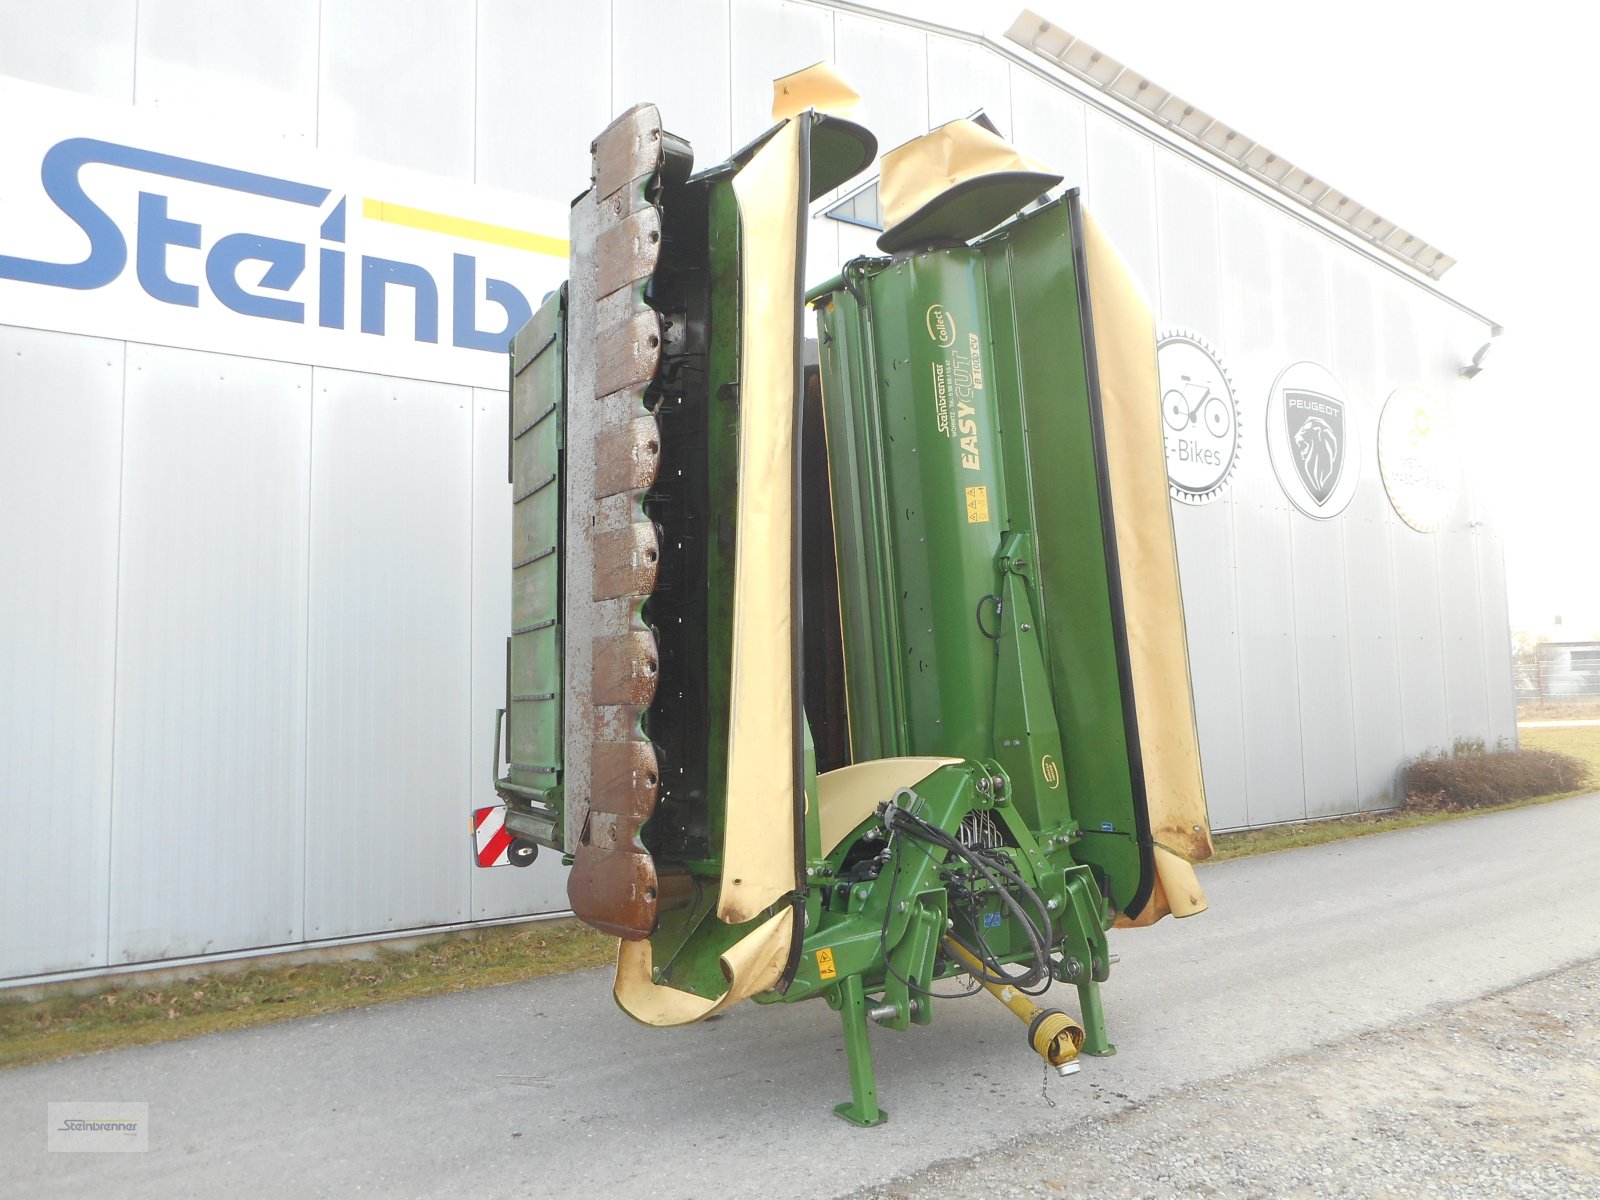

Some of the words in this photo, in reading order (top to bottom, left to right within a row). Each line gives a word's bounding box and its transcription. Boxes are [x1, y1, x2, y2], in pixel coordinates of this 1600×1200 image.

[0, 136, 558, 354] Steinb
[933, 311, 948, 341] Collect
[970, 337, 978, 351] CV
[972, 353, 981, 375] 1000
[935, 363, 950, 438] Steinbrenner
[1289, 399, 1340, 417] PEUGEOT
